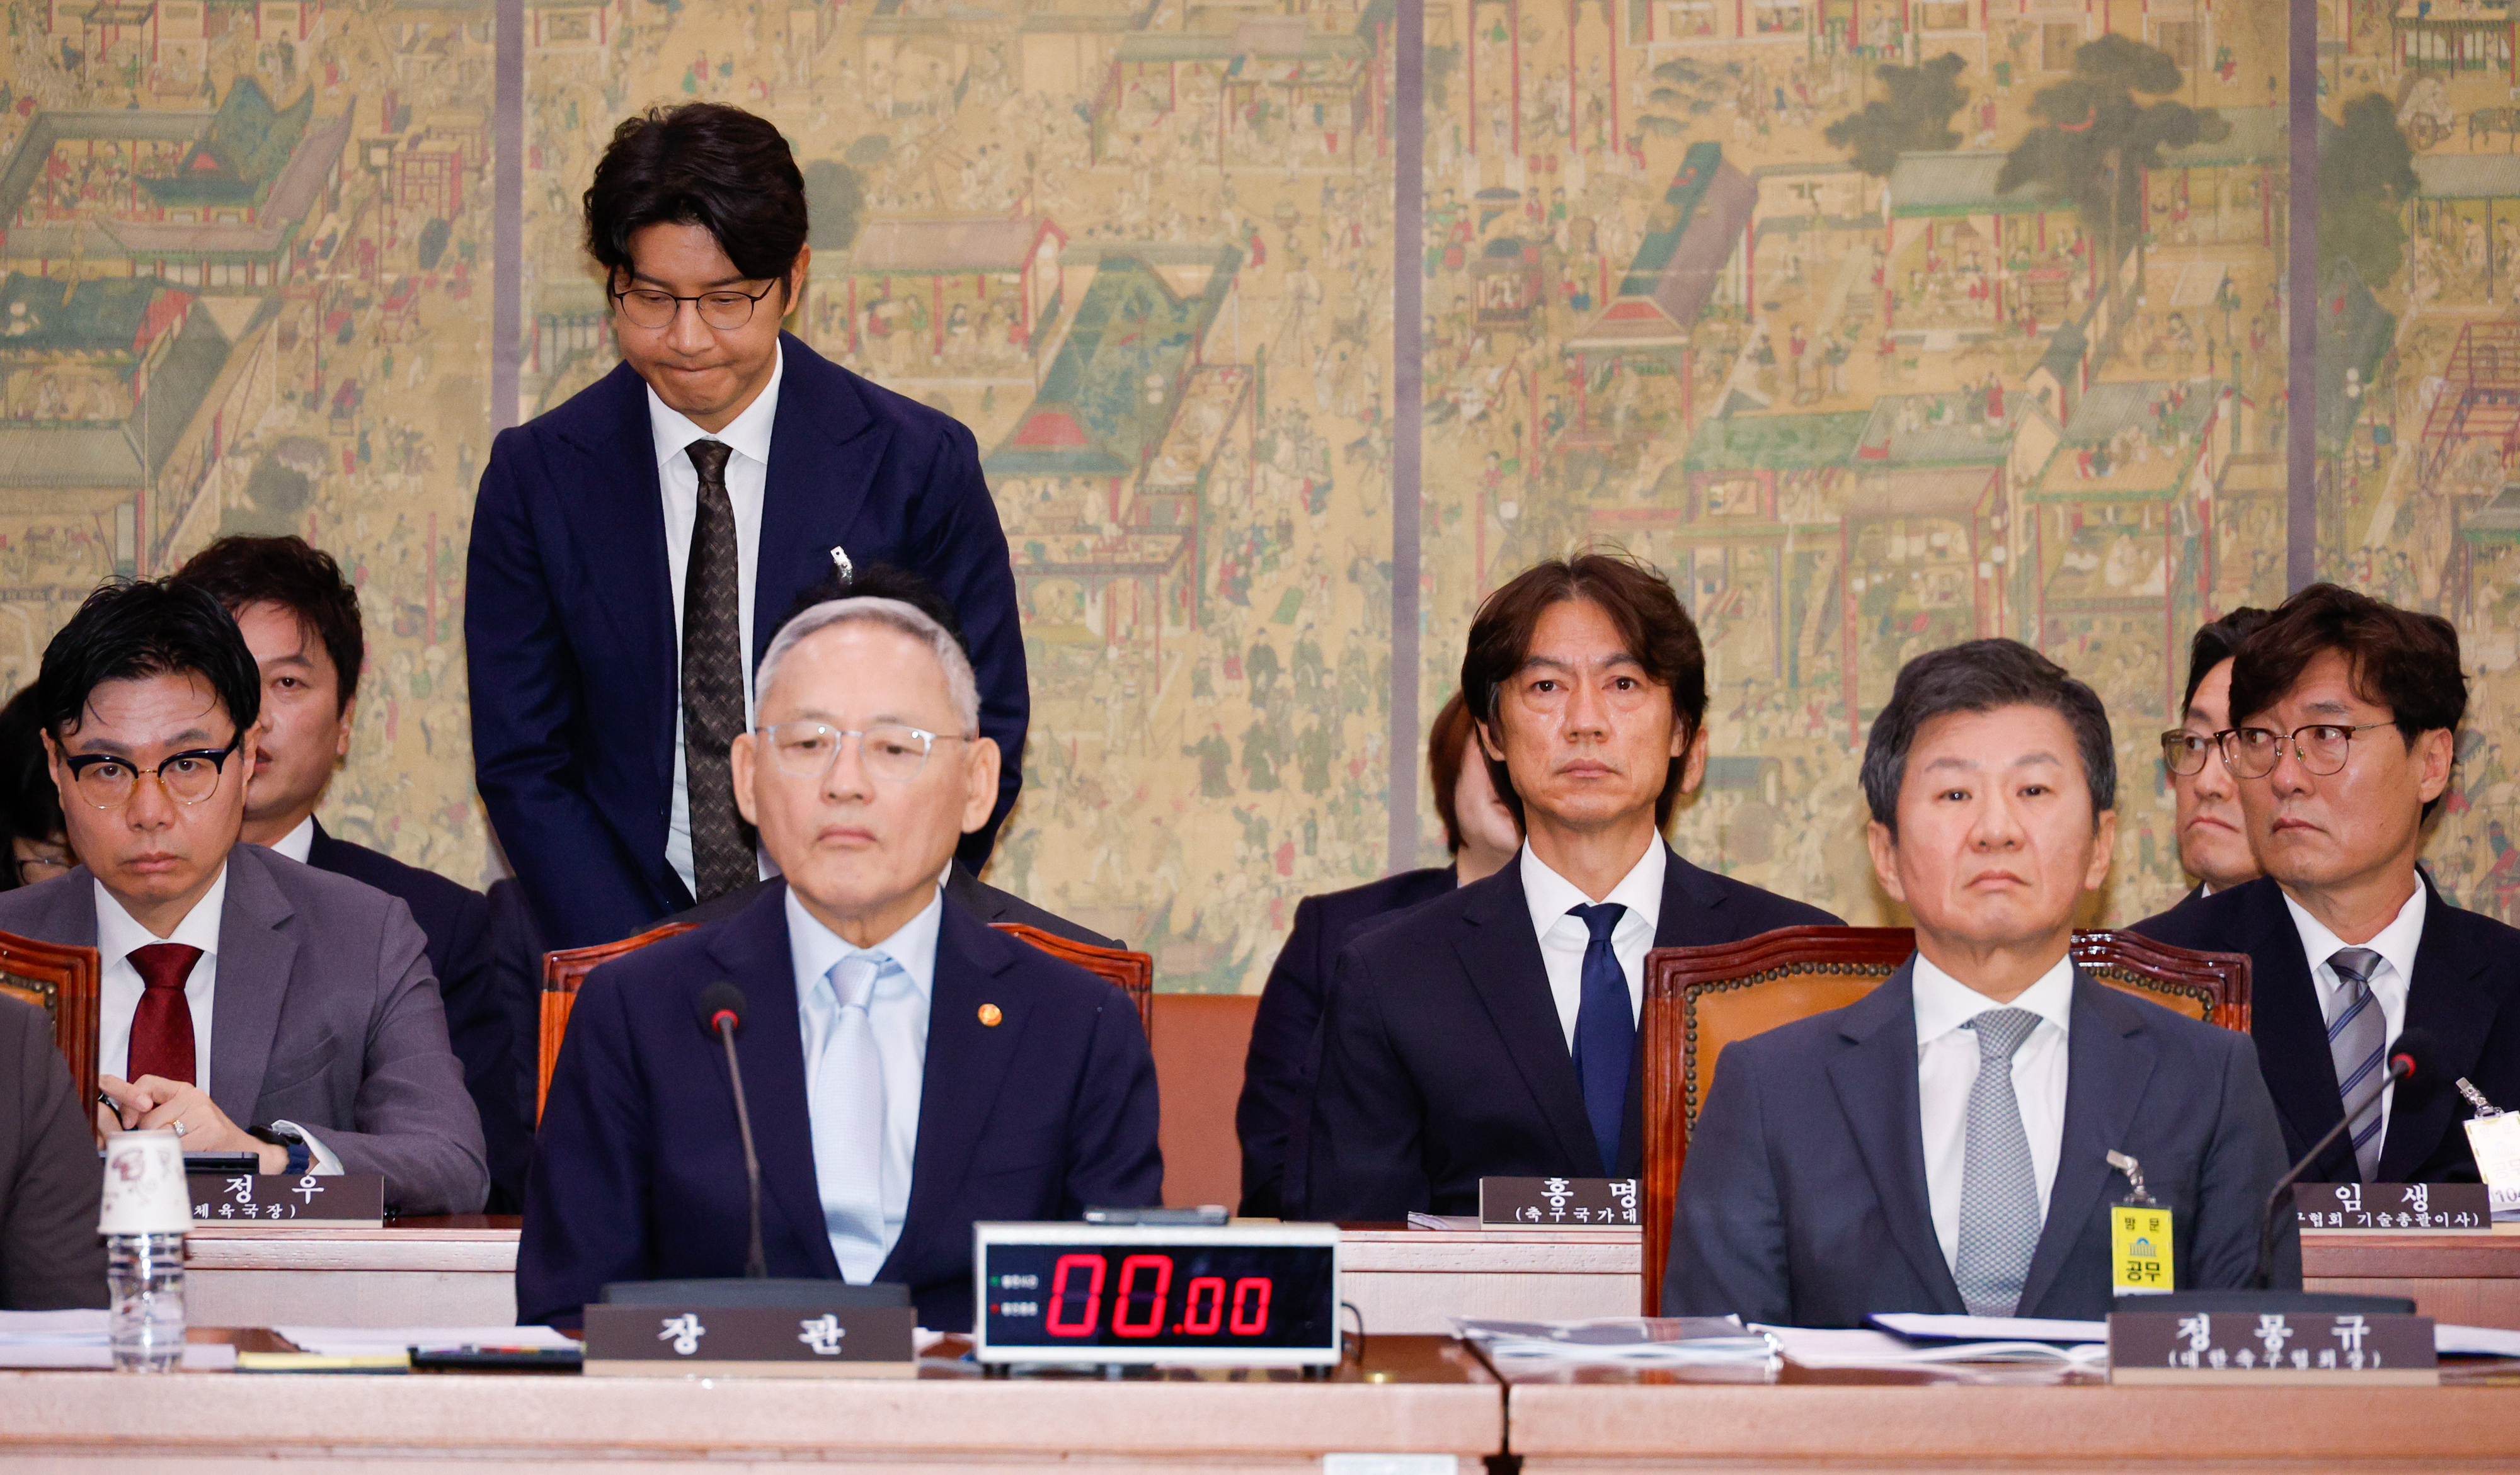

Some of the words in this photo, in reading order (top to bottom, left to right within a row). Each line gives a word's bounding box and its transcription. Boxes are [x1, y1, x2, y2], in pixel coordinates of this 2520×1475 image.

[2495, 1187, 2520, 1204] 10
[2357, 1210, 2479, 1228] 기술총괄이사)
[2126, 1260, 2161, 1282] 공무
